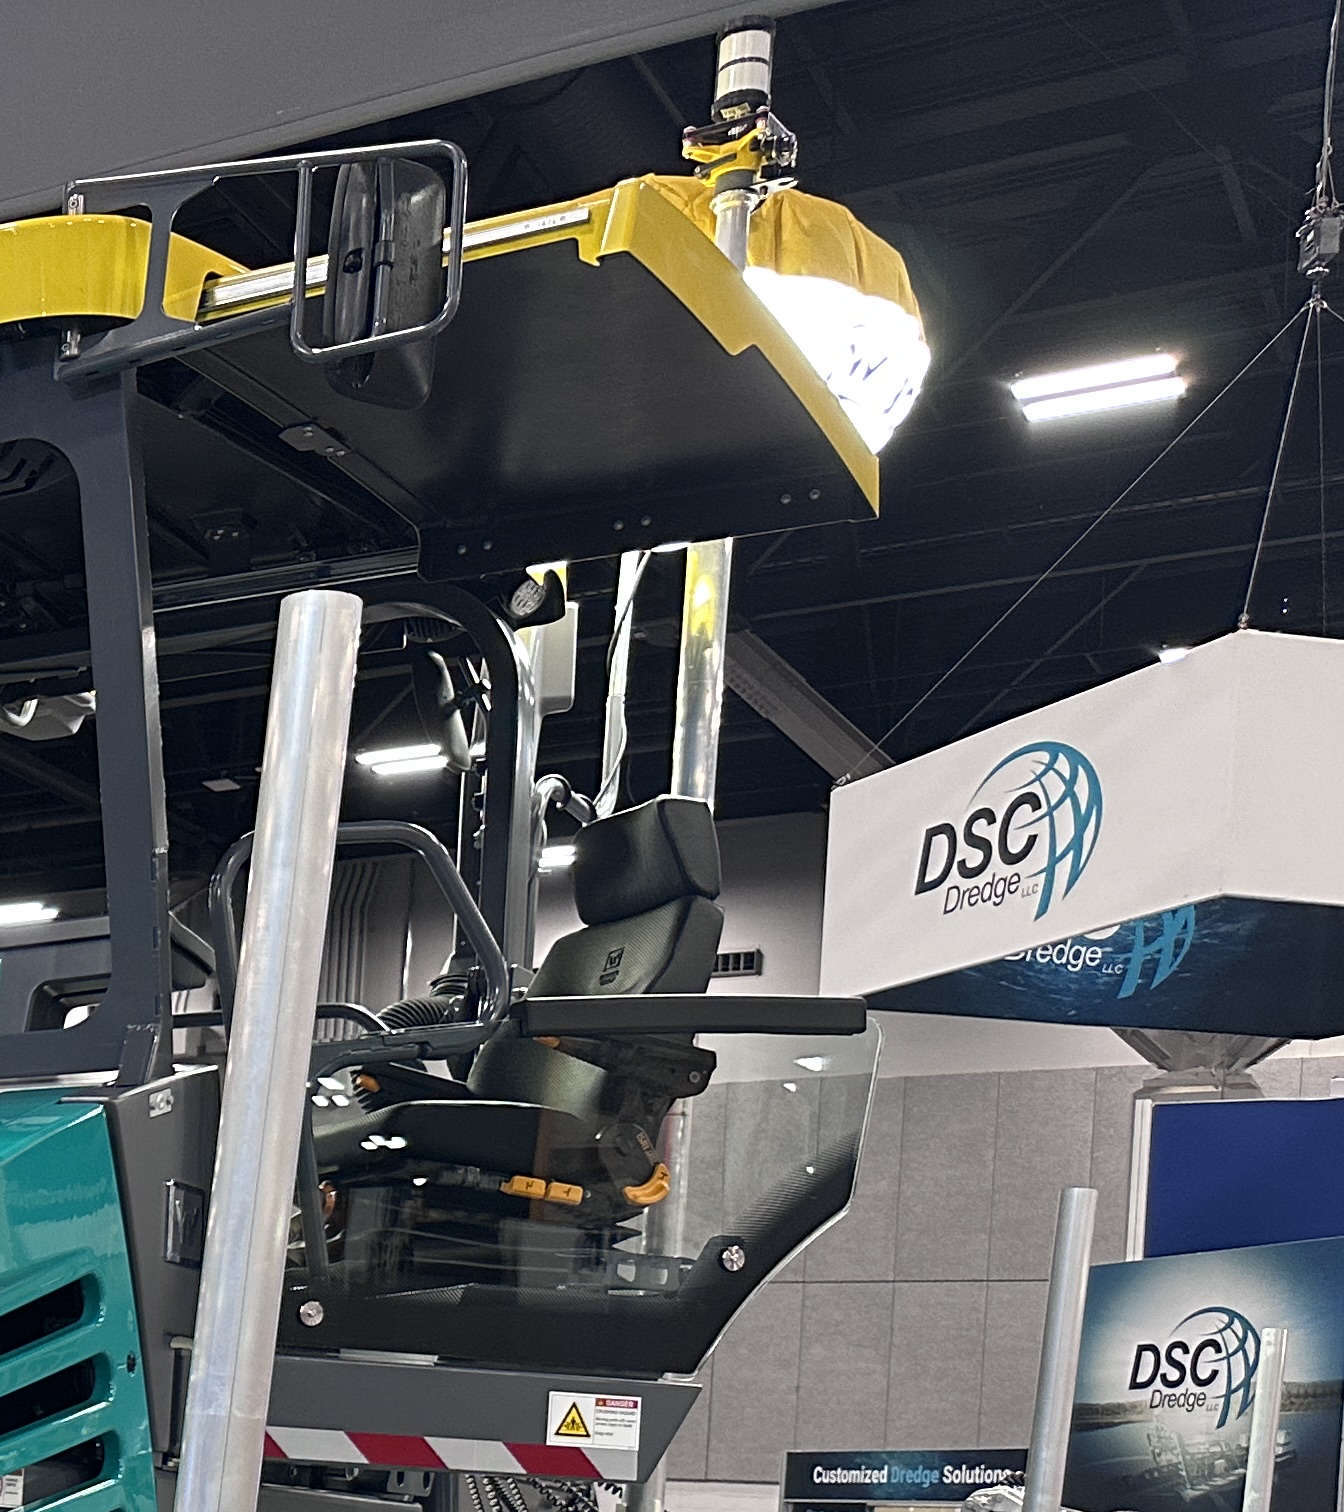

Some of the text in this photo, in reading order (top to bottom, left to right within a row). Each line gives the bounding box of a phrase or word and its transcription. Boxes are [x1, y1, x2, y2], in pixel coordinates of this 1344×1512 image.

[914, 791, 1042, 896] DSC
[943, 872, 1039, 915] Dredge LLC
[1004, 938, 1124, 974] redge LLC
[1128, 1338, 1223, 1391] DSC
[1149, 1388, 1207, 1412] Dredge
[813, 1465, 888, 1484] Customized
[891, 1464, 940, 1487] Dredge
